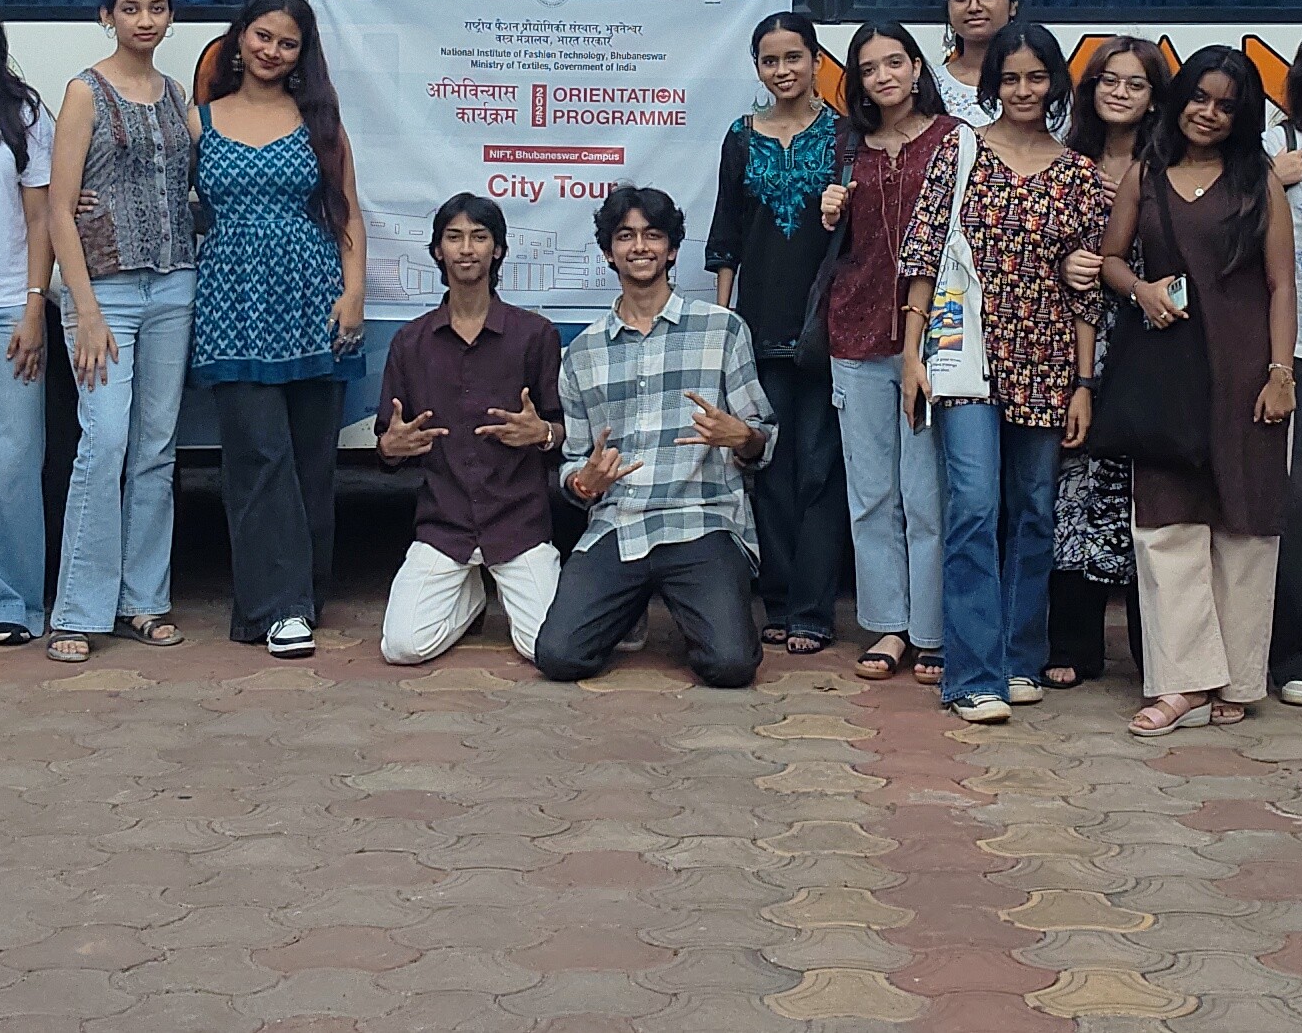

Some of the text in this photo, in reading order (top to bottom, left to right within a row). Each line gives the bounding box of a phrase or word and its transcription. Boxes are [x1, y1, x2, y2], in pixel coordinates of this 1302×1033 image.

[464, 19, 493, 33] राष्ट्रीय
[495, 19, 519, 32] फैशन
[495, 34, 514, 45] वस्त्र
[558, 35, 580, 47] भारत
[583, 36, 613, 47] सरकार
[440, 47, 667, 62] National Institute of Fashion Technology, Bhubaneswar
[470, 59, 637, 72] Ministry of Textiles, Government of India
[426, 76, 519, 103] अभिविन्यास
[553, 87, 686, 104] ORIENTATION
[455, 101, 519, 126] कार्यक्रम
[535, 87, 544, 124] 2025
[553, 109, 687, 126] PROGRAMME
[489, 149, 620, 162] NIFT, Bhubaneswar Campus
[487, 173, 618, 203] City Tour
